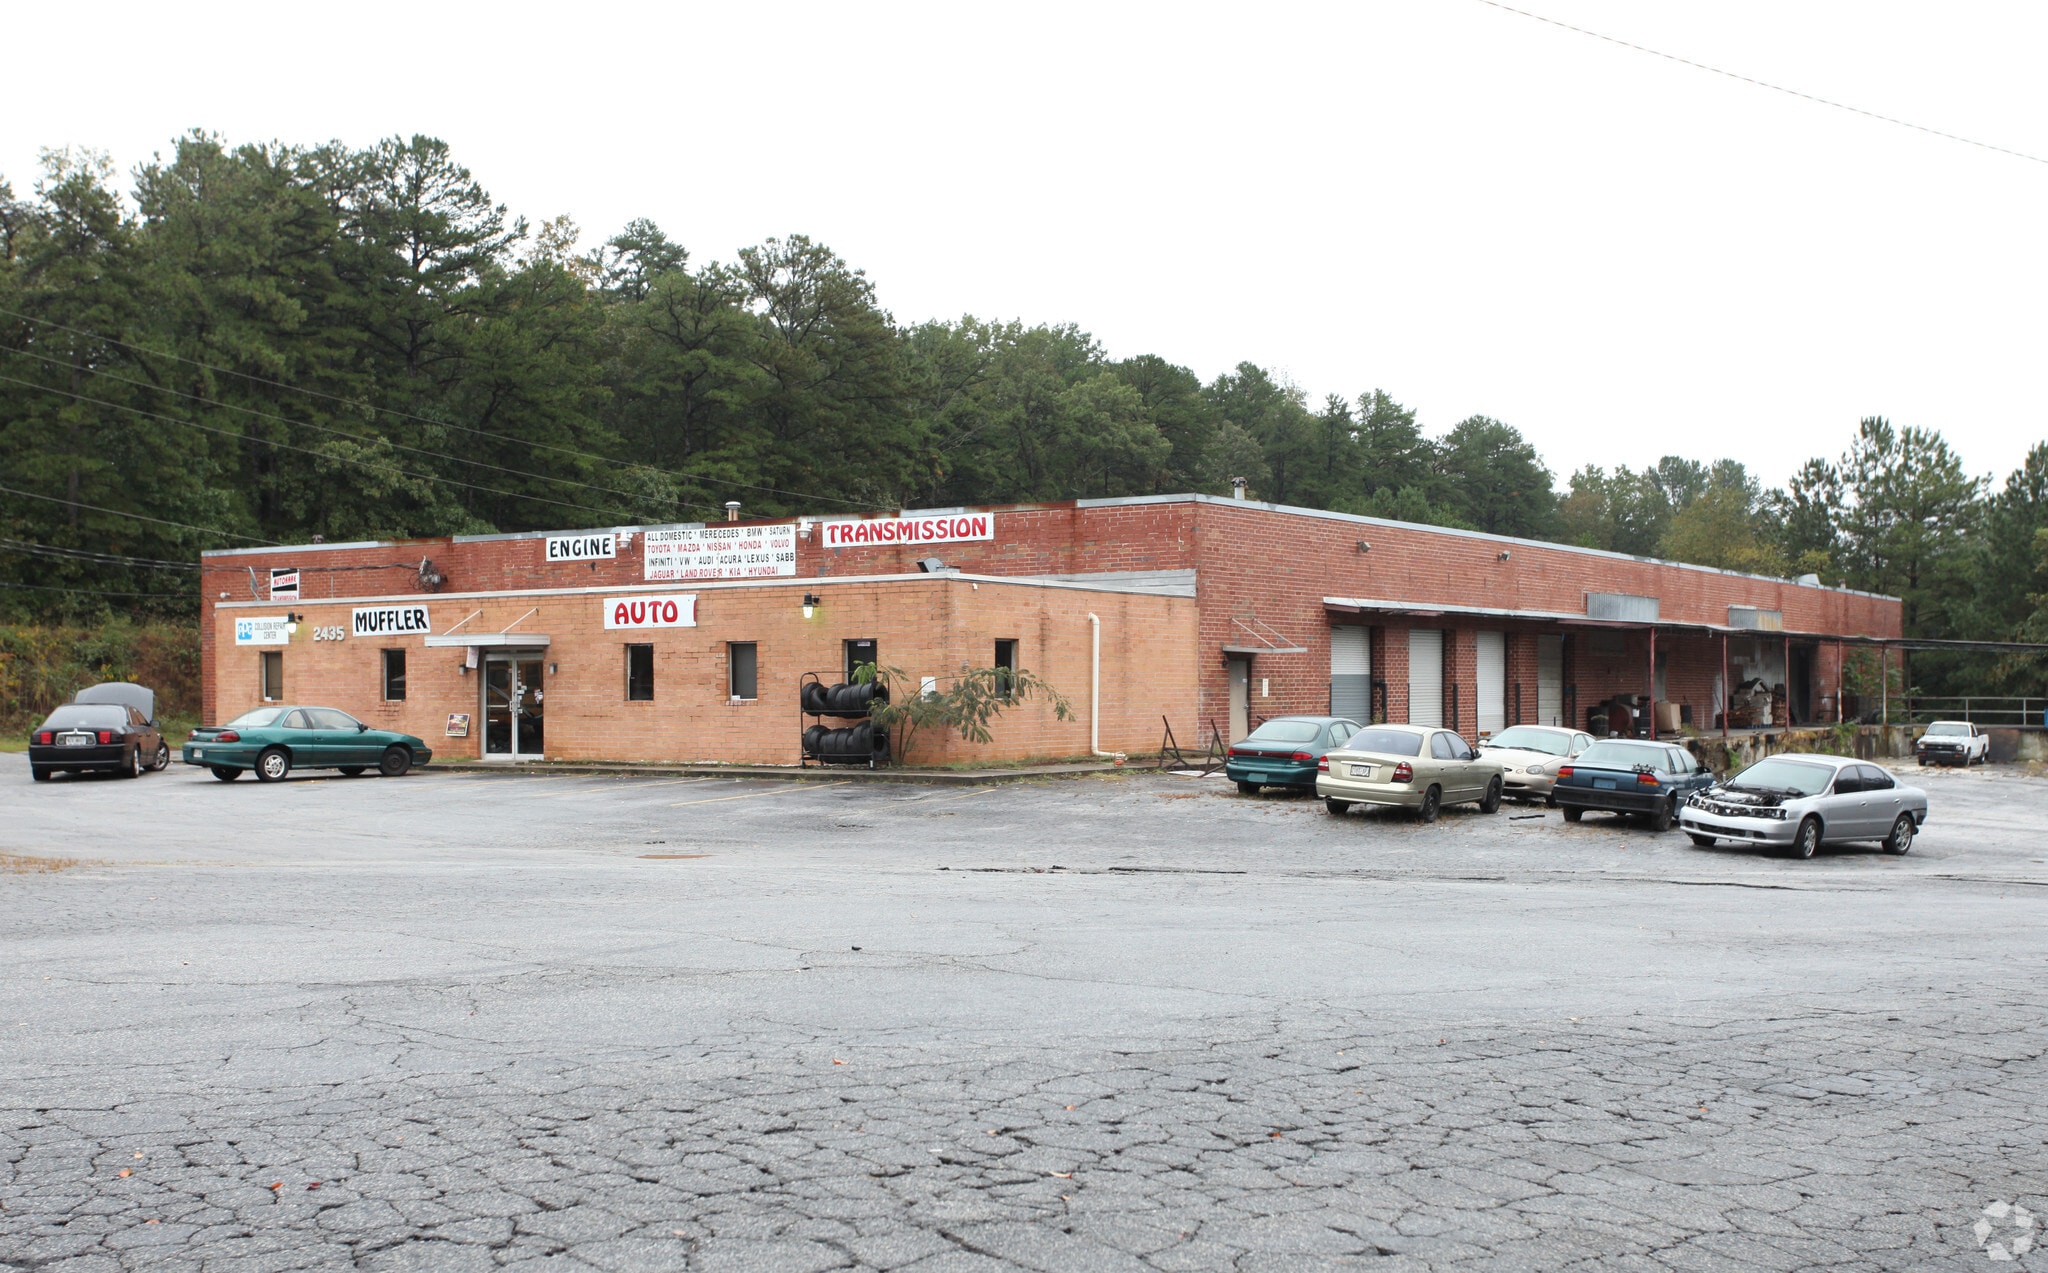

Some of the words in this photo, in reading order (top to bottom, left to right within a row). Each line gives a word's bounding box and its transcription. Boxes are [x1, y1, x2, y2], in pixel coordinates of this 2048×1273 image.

[647, 532, 659, 541] ALL
[660, 530, 693, 541] DOMESTIC
[699, 528, 740, 539] MERECEDES
[746, 527, 763, 537] BMW
[769, 526, 791, 536] SATURN
[826, 516, 987, 544] TRANSMISSION
[549, 537, 612, 558] ENGINE
[647, 544, 671, 554] TOYOTA
[677, 543, 701, 553] MAZDA
[706, 541, 732, 552] NISSAN
[738, 540, 762, 550] HONDA
[770, 538, 790, 548] VOLVO
[648, 557, 673, 567] INFINITI
[679, 556, 691, 566] VW
[698, 555, 714, 565] AUDI
[719, 554, 742, 564] ACURA
[746, 553, 770, 564] LEXUS
[775, 552, 795, 562] SABB
[649, 569, 675, 579] JAGUAR
[680, 568, 698, 579] LAND
[699, 567, 723, 578] ROVER
[729, 567, 741, 576] KIA
[748, 566, 779, 576] HYUNDAI
[614, 599, 679, 625] AUTO
[254, 622, 273, 631] COLLISION
[355, 609, 428, 633] MUFFLER
[263, 631, 277, 640] CENTER
[313, 625, 345, 642] 2435
